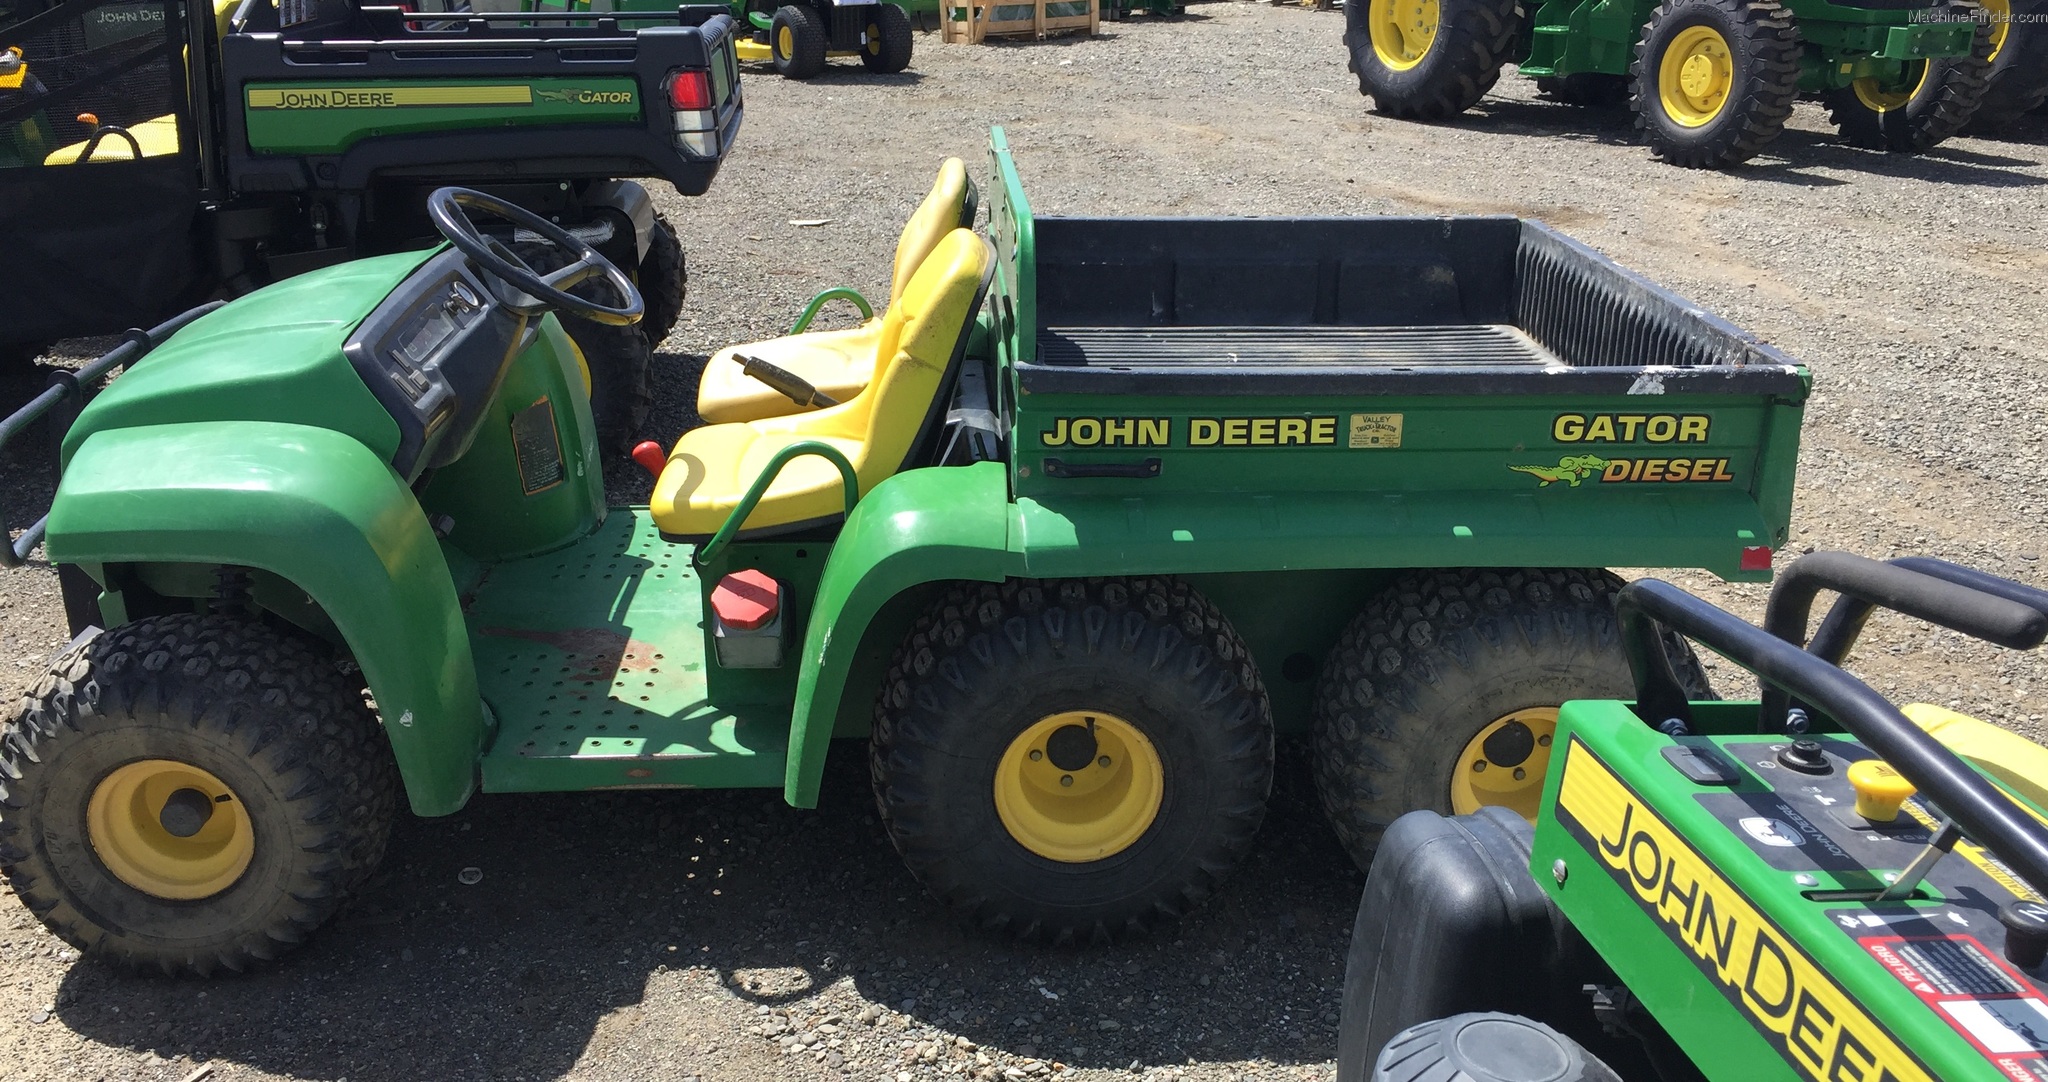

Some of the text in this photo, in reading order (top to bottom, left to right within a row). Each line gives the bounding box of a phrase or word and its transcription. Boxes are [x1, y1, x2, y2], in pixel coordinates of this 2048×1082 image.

[97, 11, 138, 23] JOHN
[275, 90, 395, 108] JOHN DEERE
[578, 90, 632, 103] GATOR
[1041, 415, 1338, 447] JOHN DEERE
[1362, 415, 1391, 423] VALLEY
[1552, 413, 1711, 443] GATOR
[1600, 456, 1735, 483] DIESEL
[1776, 804, 1850, 859] JOHN DEERE
[1979, 862, 2026, 894] CAUTION
[1600, 802, 1906, 1082] JOHN DEE
[1871, 945, 1921, 983] PELIGRO
